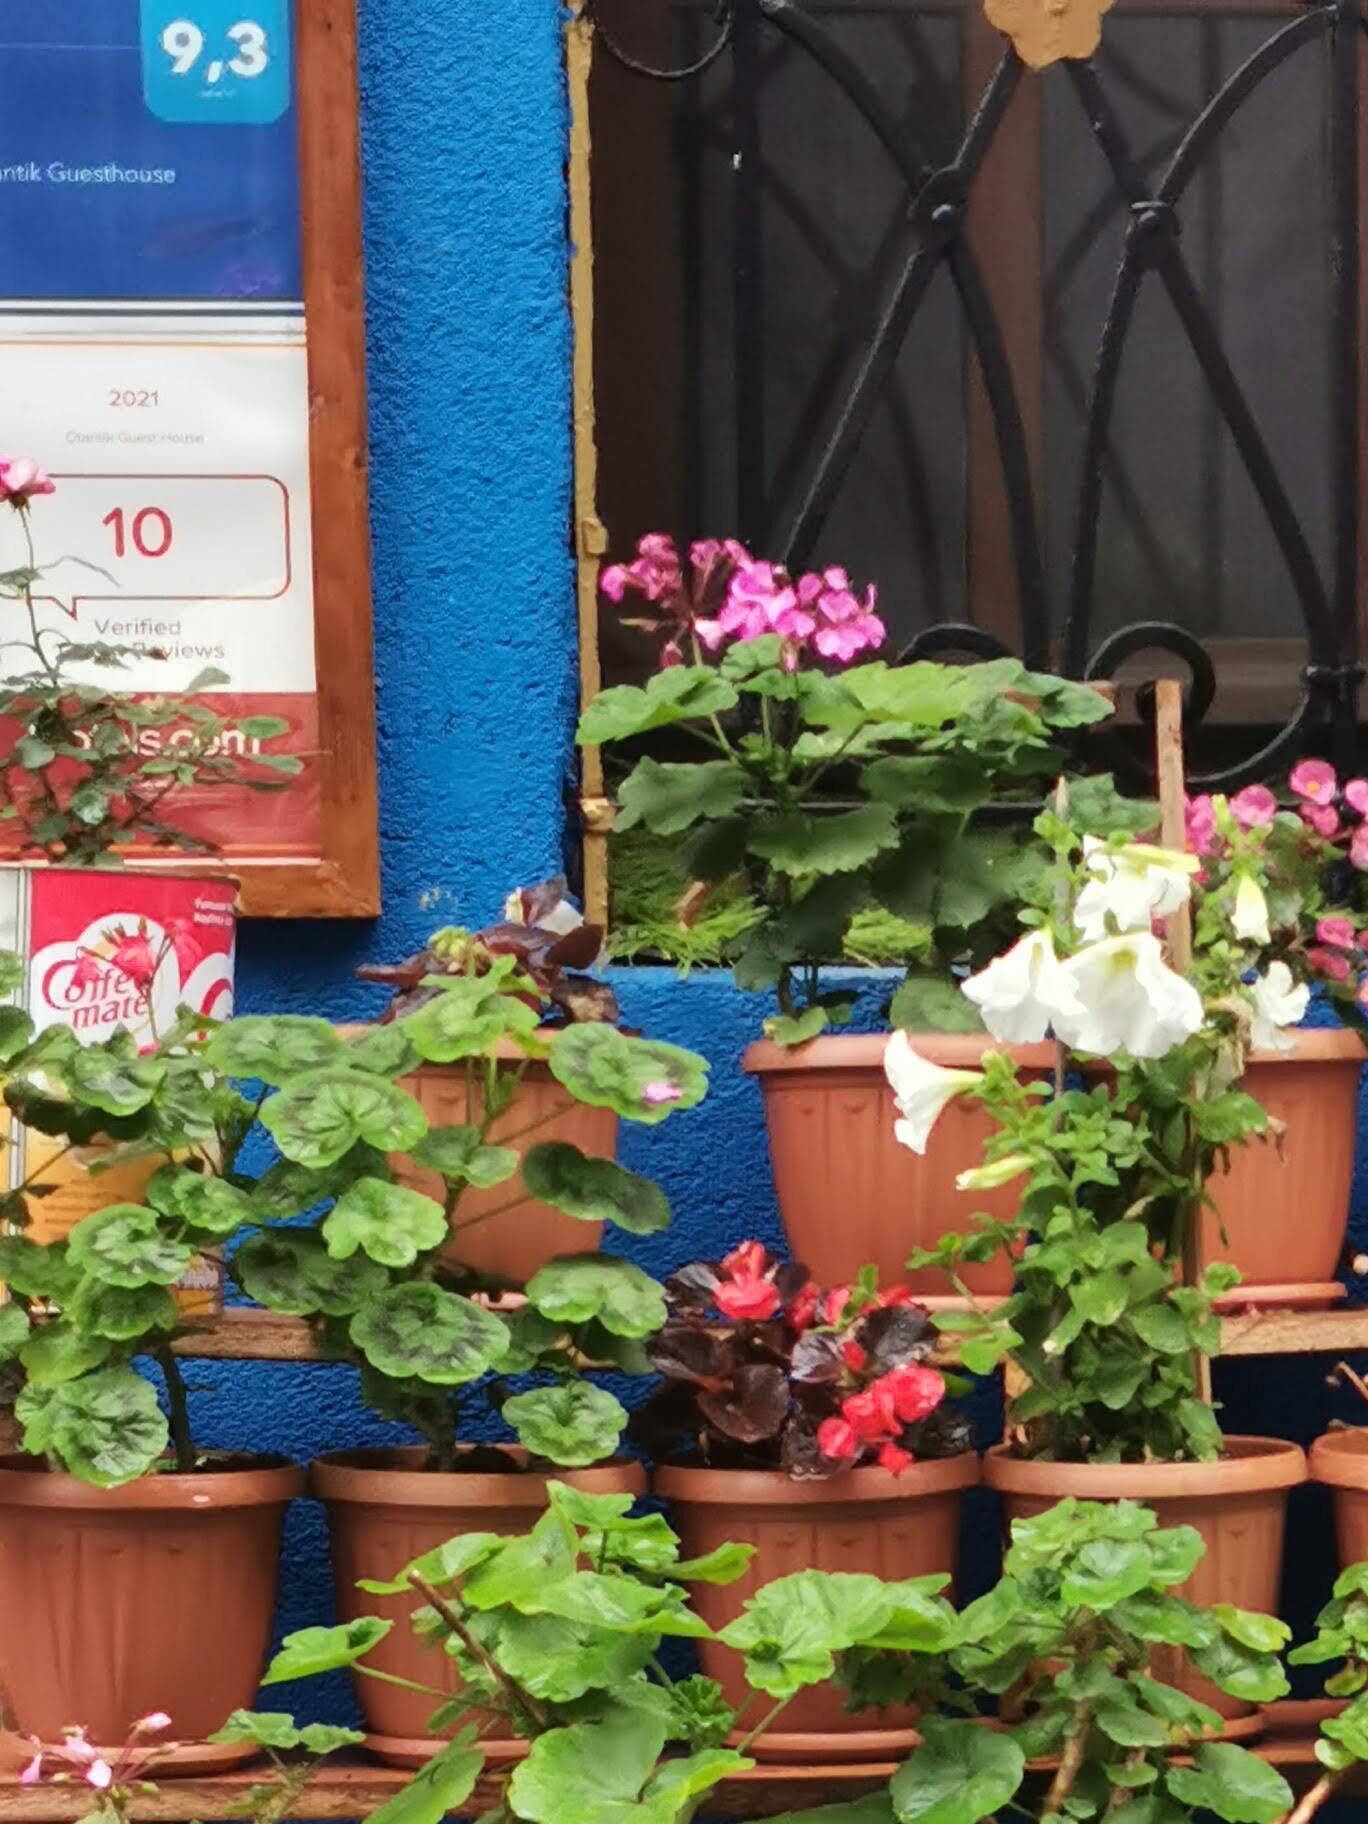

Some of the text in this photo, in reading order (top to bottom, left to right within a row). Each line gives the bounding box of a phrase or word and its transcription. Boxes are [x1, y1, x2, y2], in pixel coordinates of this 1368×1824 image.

[163, 20, 268, 84] 9,3
[0, 161, 176, 183] ntik Guesthouse
[109, 390, 159, 407] 2021
[102, 506, 173, 557] 10
[95, 618, 181, 635] Verified
[72, 996, 148, 1029] mate
